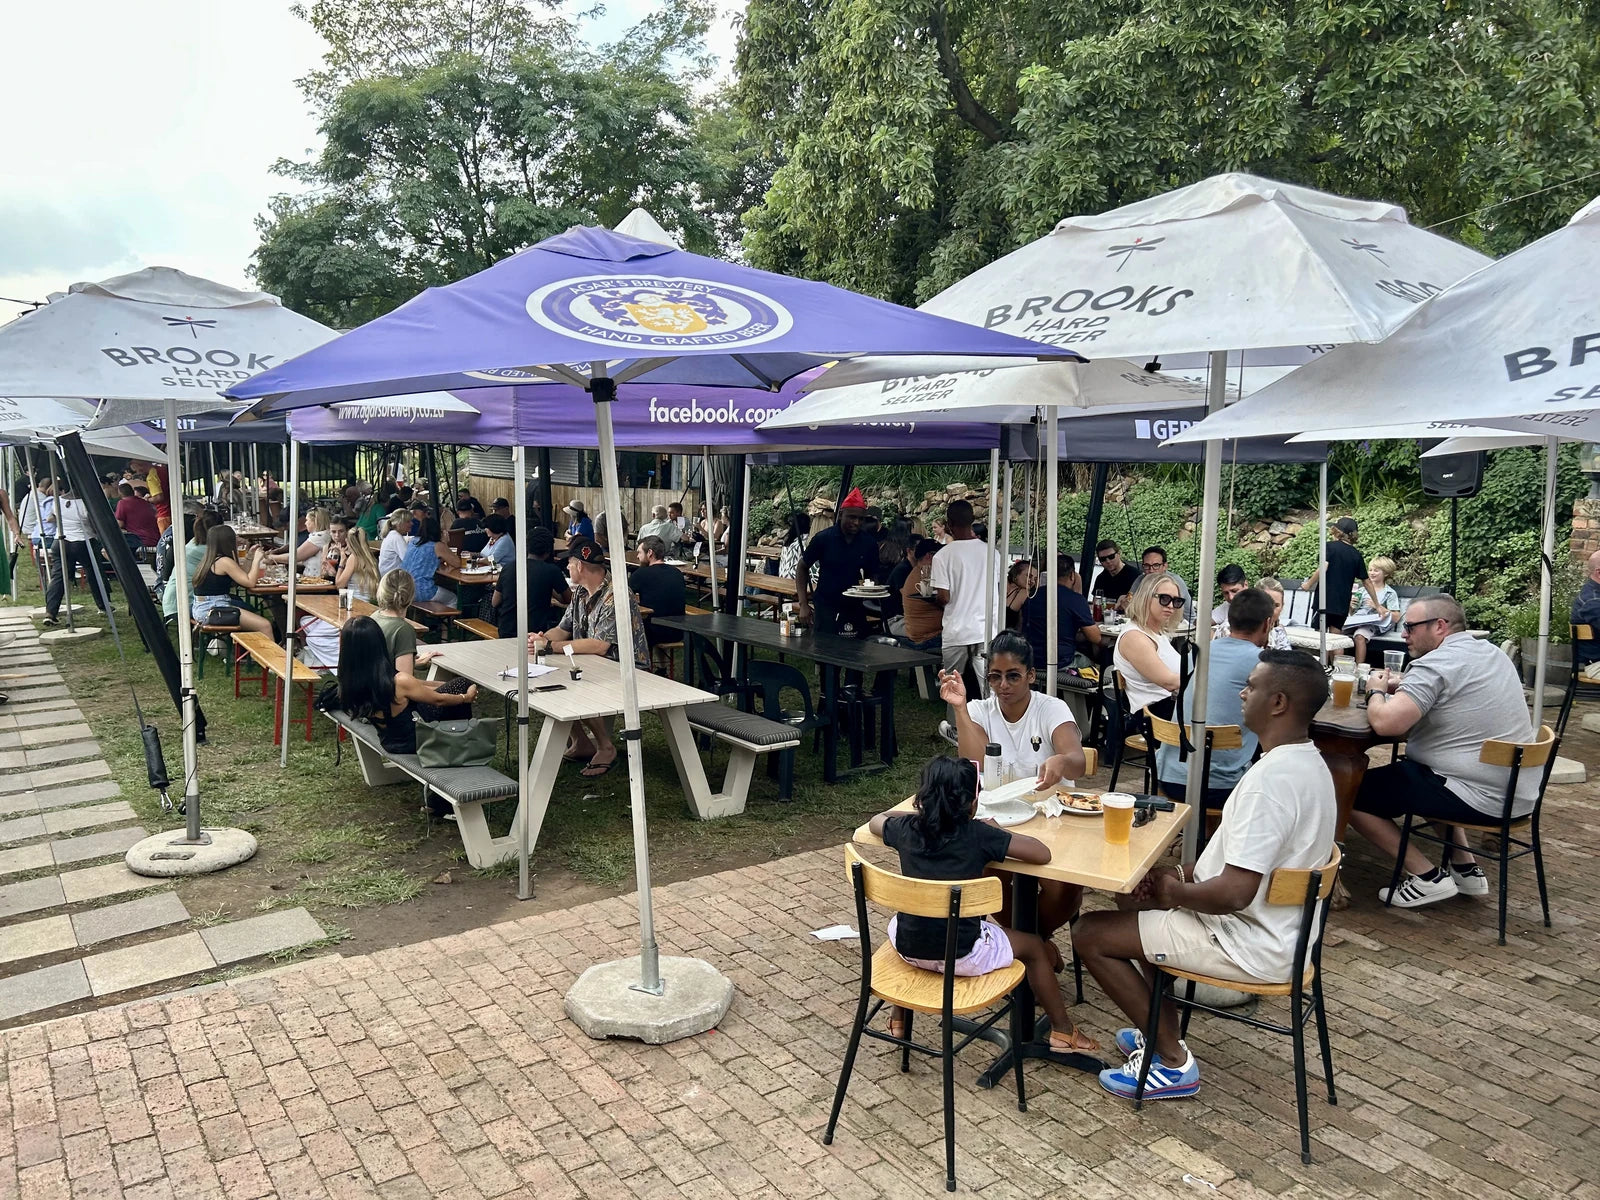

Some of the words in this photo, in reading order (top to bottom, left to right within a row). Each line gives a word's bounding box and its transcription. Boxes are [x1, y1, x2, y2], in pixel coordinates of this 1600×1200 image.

[569, 280, 629, 295] AGAR'S
[630, 280, 718, 293] BREWERY
[984, 285, 1194, 328] BROOKS
[1023, 316, 1110, 332] HARD
[579, 325, 642, 343] HAND
[650, 333, 738, 345] CRAFTED
[737, 322, 772, 338] BEER
[101, 346, 288, 368] BROOK
[172, 366, 251, 379] HARD
[161, 376, 237, 388] SELTZ
[905, 378, 958, 394] HARD
[881, 389, 954, 406] SELTZER
